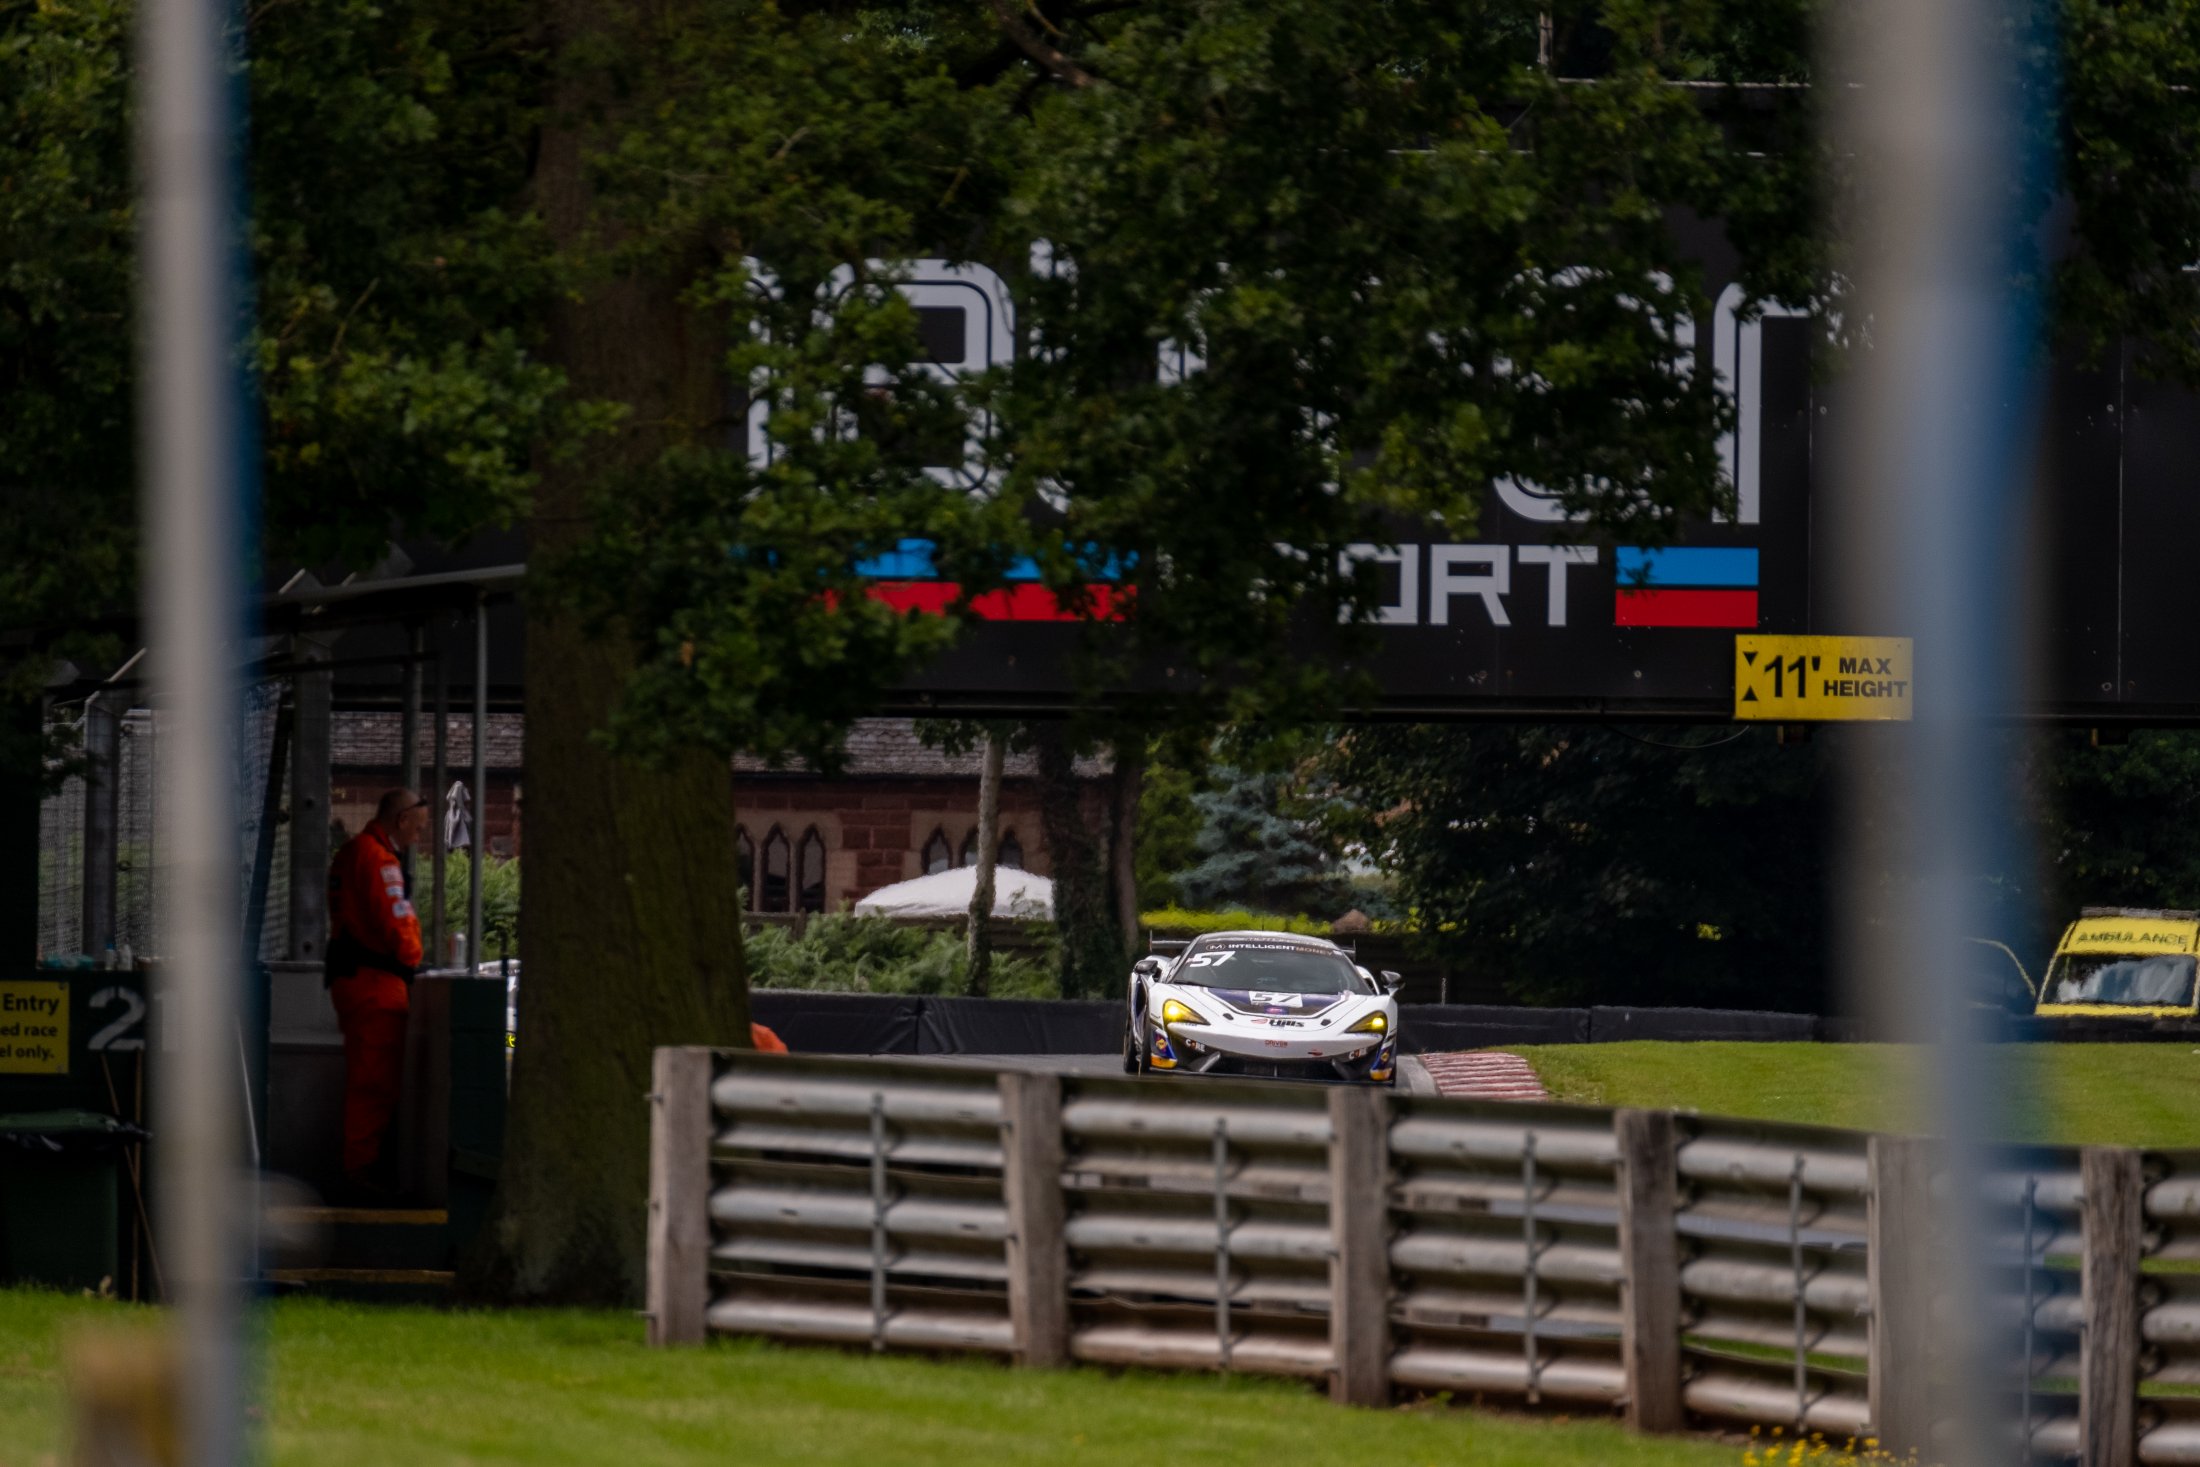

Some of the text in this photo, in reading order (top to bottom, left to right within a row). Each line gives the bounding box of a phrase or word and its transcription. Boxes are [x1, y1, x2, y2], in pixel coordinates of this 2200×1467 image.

[1839, 657, 1892, 675] MAX
[1823, 680, 1908, 697] HEIGHT
[1189, 951, 1236, 968] 57
[3, 993, 60, 1016] Entry
[1252, 993, 1300, 1003] 57
[88, 986, 146, 1051] 2
[24, 1025, 58, 1037] race
[15, 1044, 55, 1061] only.
